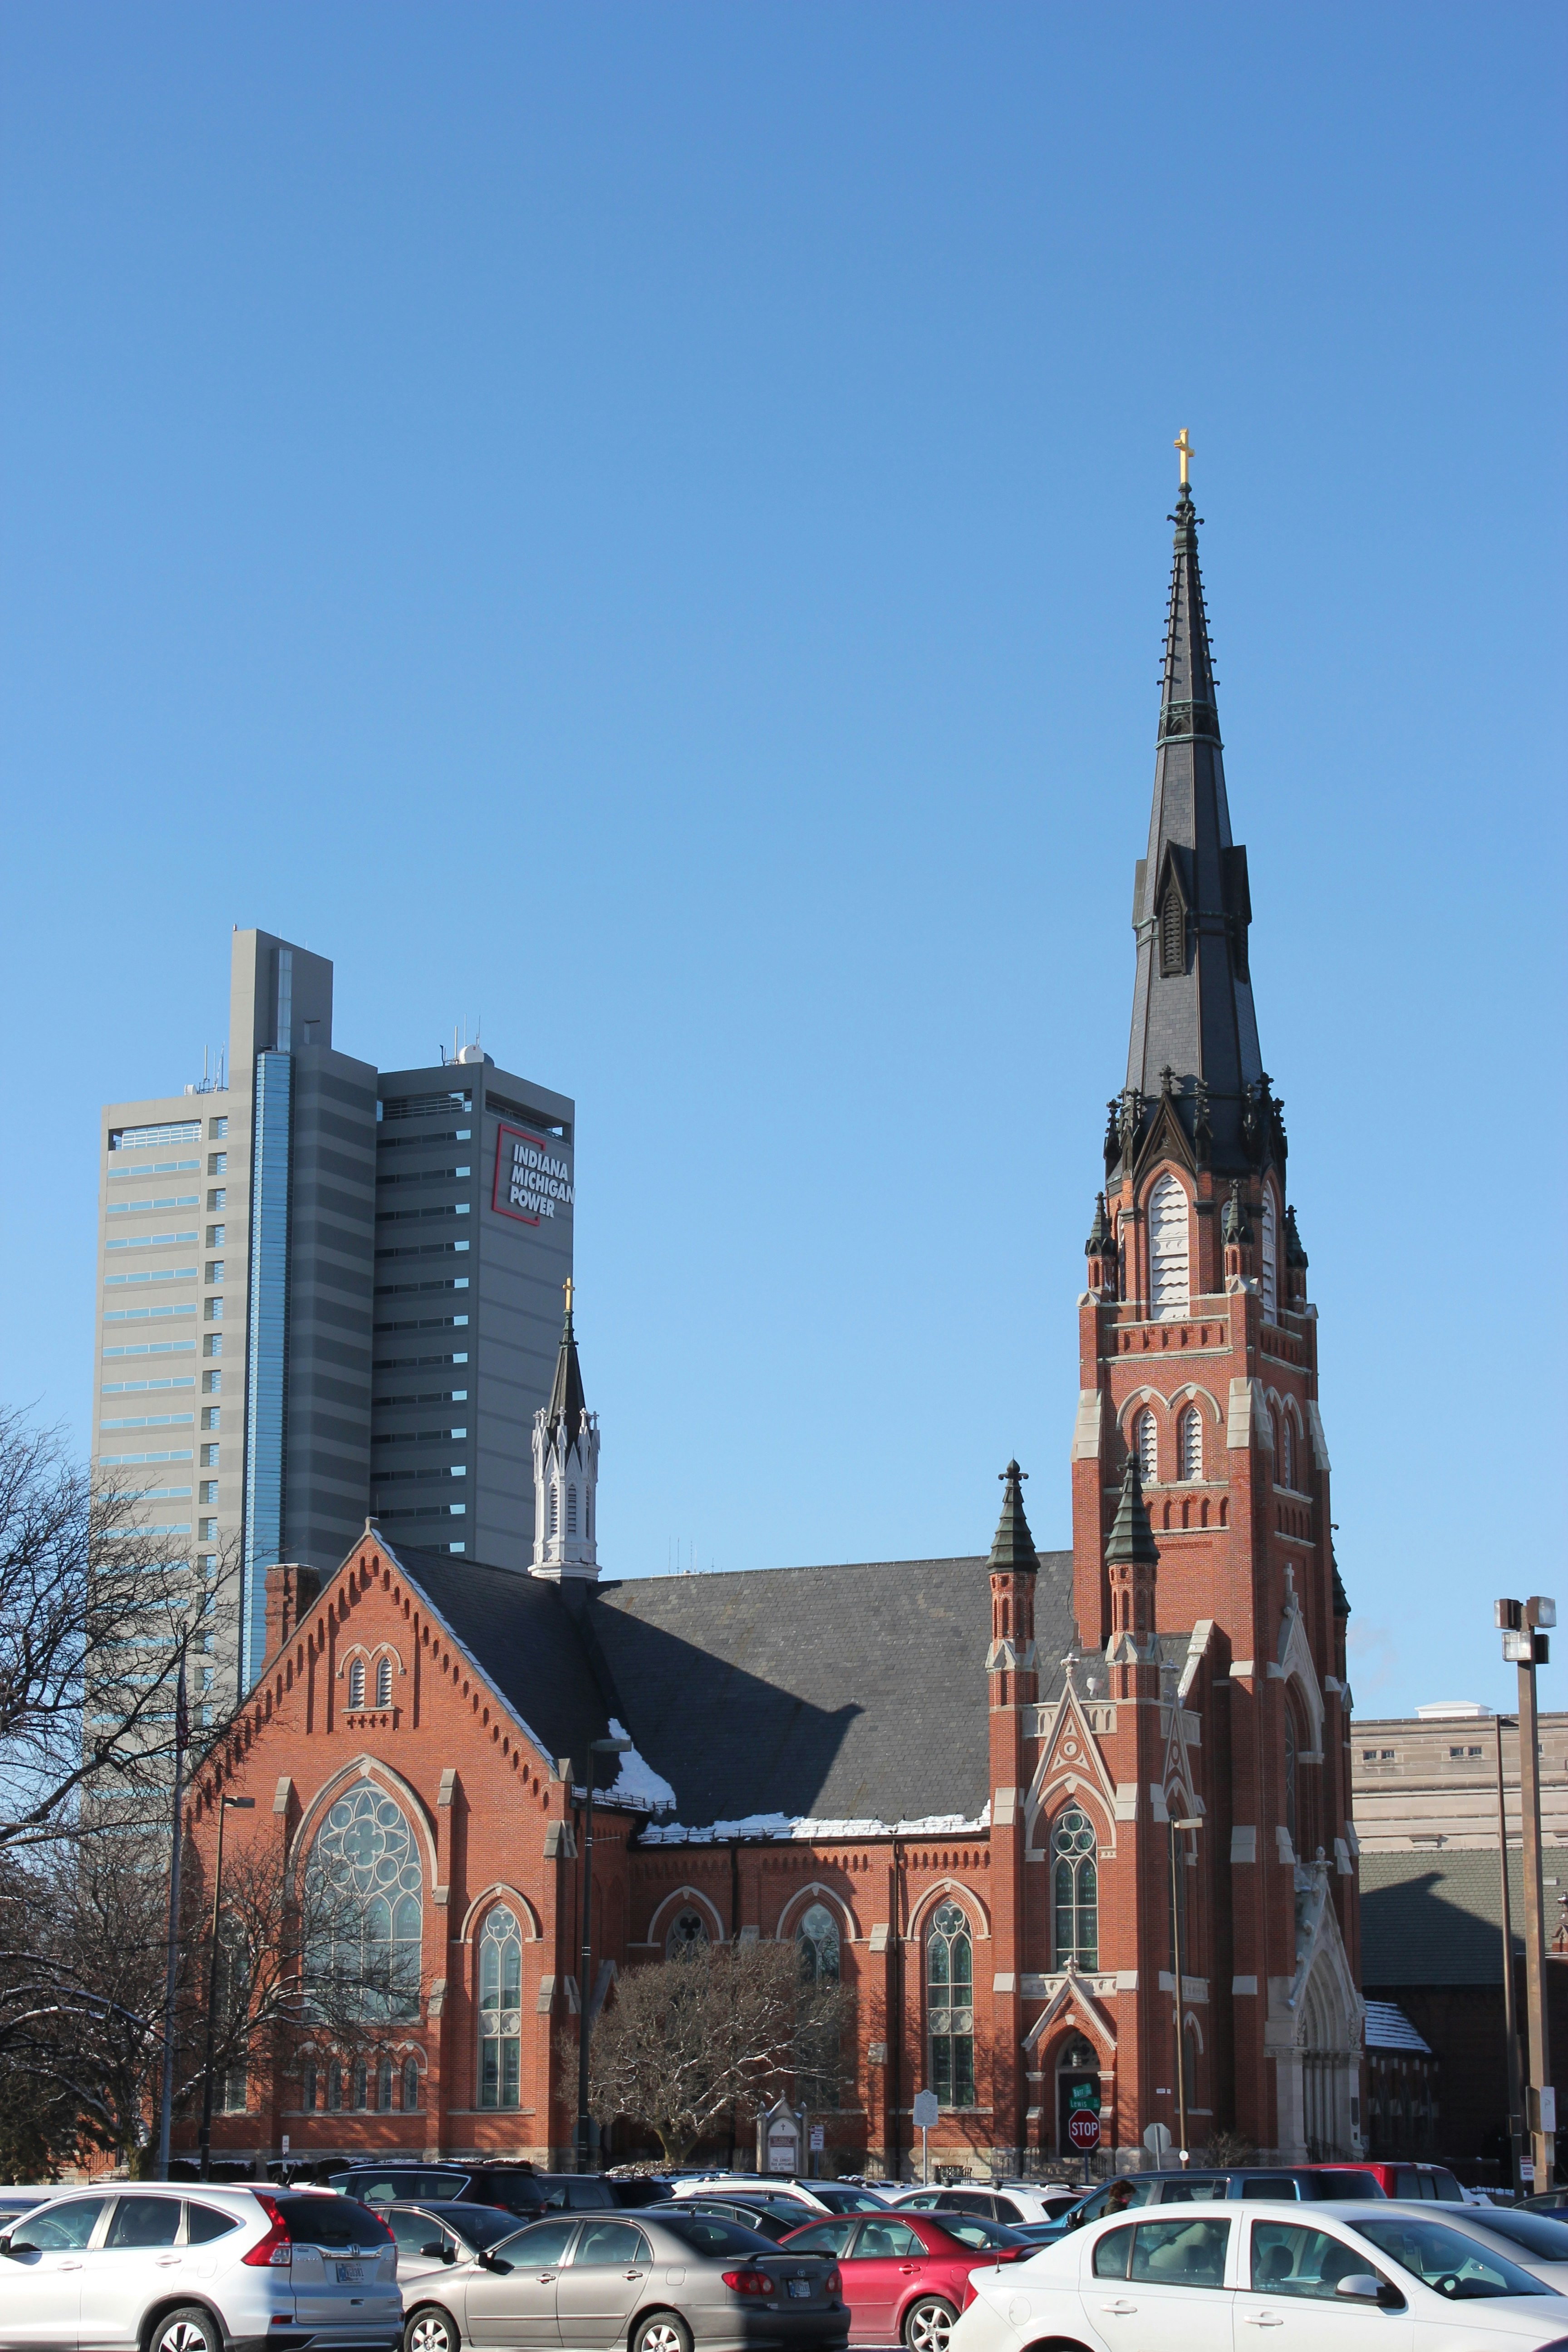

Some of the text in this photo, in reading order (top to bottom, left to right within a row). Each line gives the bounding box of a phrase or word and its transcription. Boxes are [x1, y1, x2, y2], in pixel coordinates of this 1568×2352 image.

[513, 1144, 568, 1181] INDIANA
[511, 1164, 575, 1205] MICHIGAN
[510, 1185, 555, 1218] POWER
[1070, 2099, 1087, 2107] Lewis
[1073, 2089, 1084, 2097] Barr
[1072, 2122, 1098, 2136] STOP
